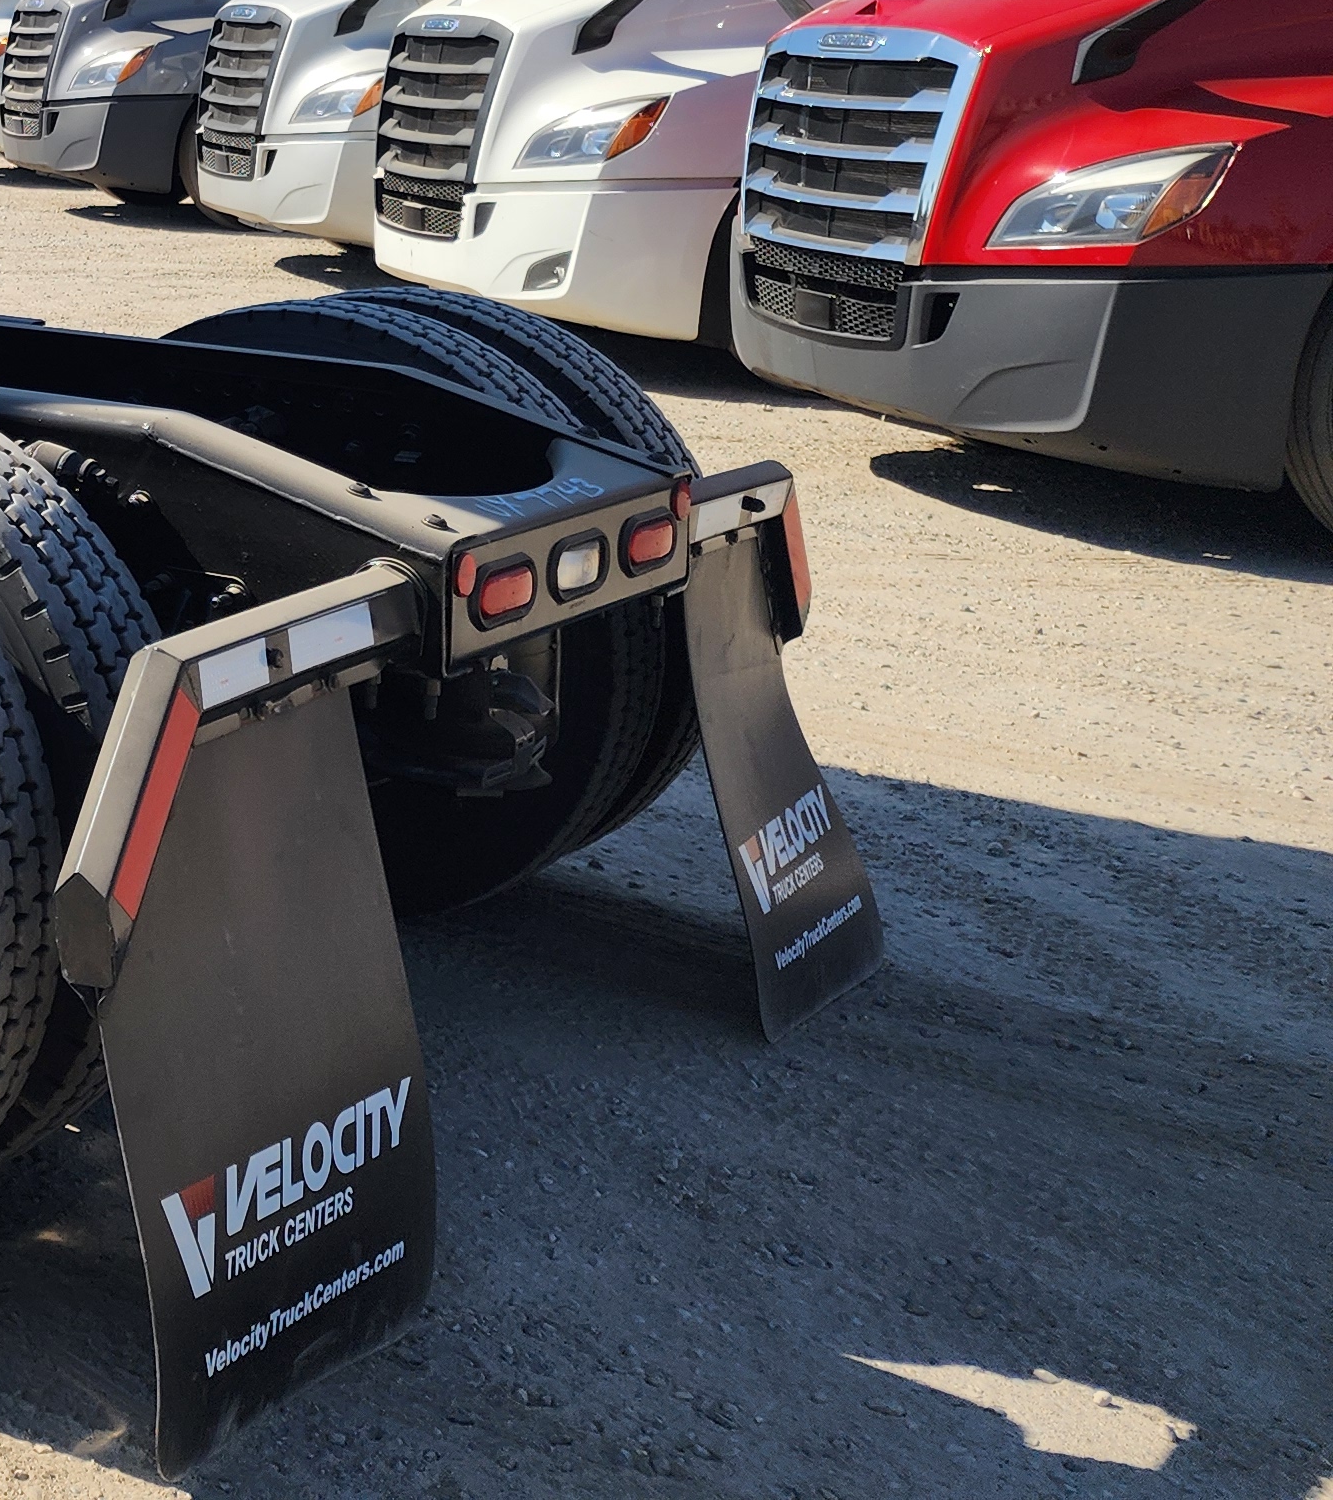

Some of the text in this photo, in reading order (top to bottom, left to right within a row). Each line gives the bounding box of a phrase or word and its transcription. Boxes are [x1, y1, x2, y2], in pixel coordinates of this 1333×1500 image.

[758, 784, 831, 877] VELOCITY
[771, 852, 824, 905] TRUCK CENTERS
[774, 895, 863, 970] VelocityTruckCenters.com
[226, 1076, 412, 1237] VELOCITY
[225, 1185, 354, 1281] TRUCK CENTERS
[205, 1238, 405, 1378] VelocityTruckCenters.com
